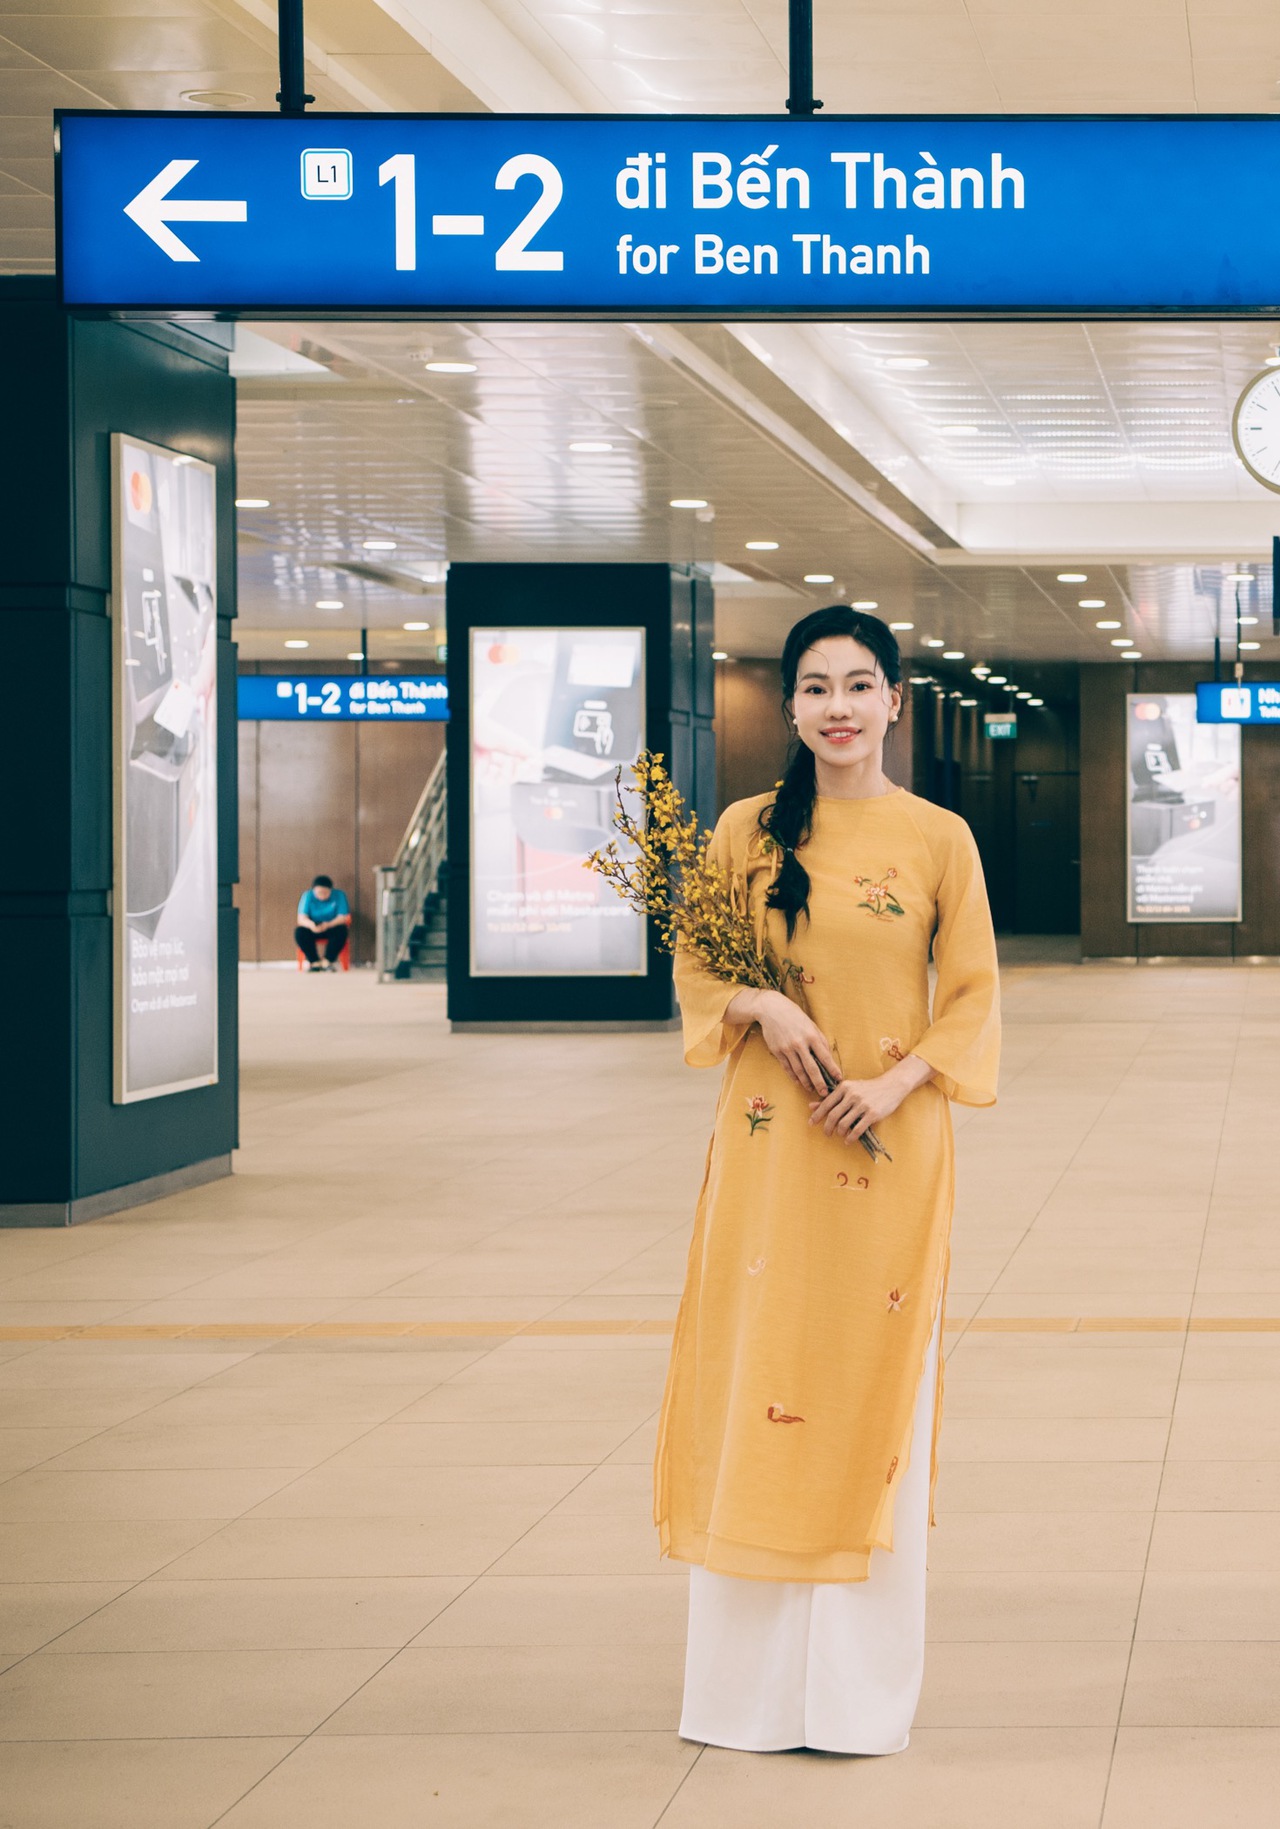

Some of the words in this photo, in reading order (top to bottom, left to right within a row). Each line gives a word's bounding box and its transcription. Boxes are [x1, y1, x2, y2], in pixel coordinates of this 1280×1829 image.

[317, 165, 337, 183] L1
[616, 152, 666, 209] đi
[693, 145, 809, 209] Bến
[831, 152, 1025, 209] Thành
[378, 153, 564, 271] 1-2
[616, 234, 680, 275] for
[695, 234, 778, 275] Ben
[793, 234, 930, 275] Thanh
[294, 682, 341, 714] 1-2
[399, 681, 448, 699] Thành
[989, 724, 1011, 737] EXIT
